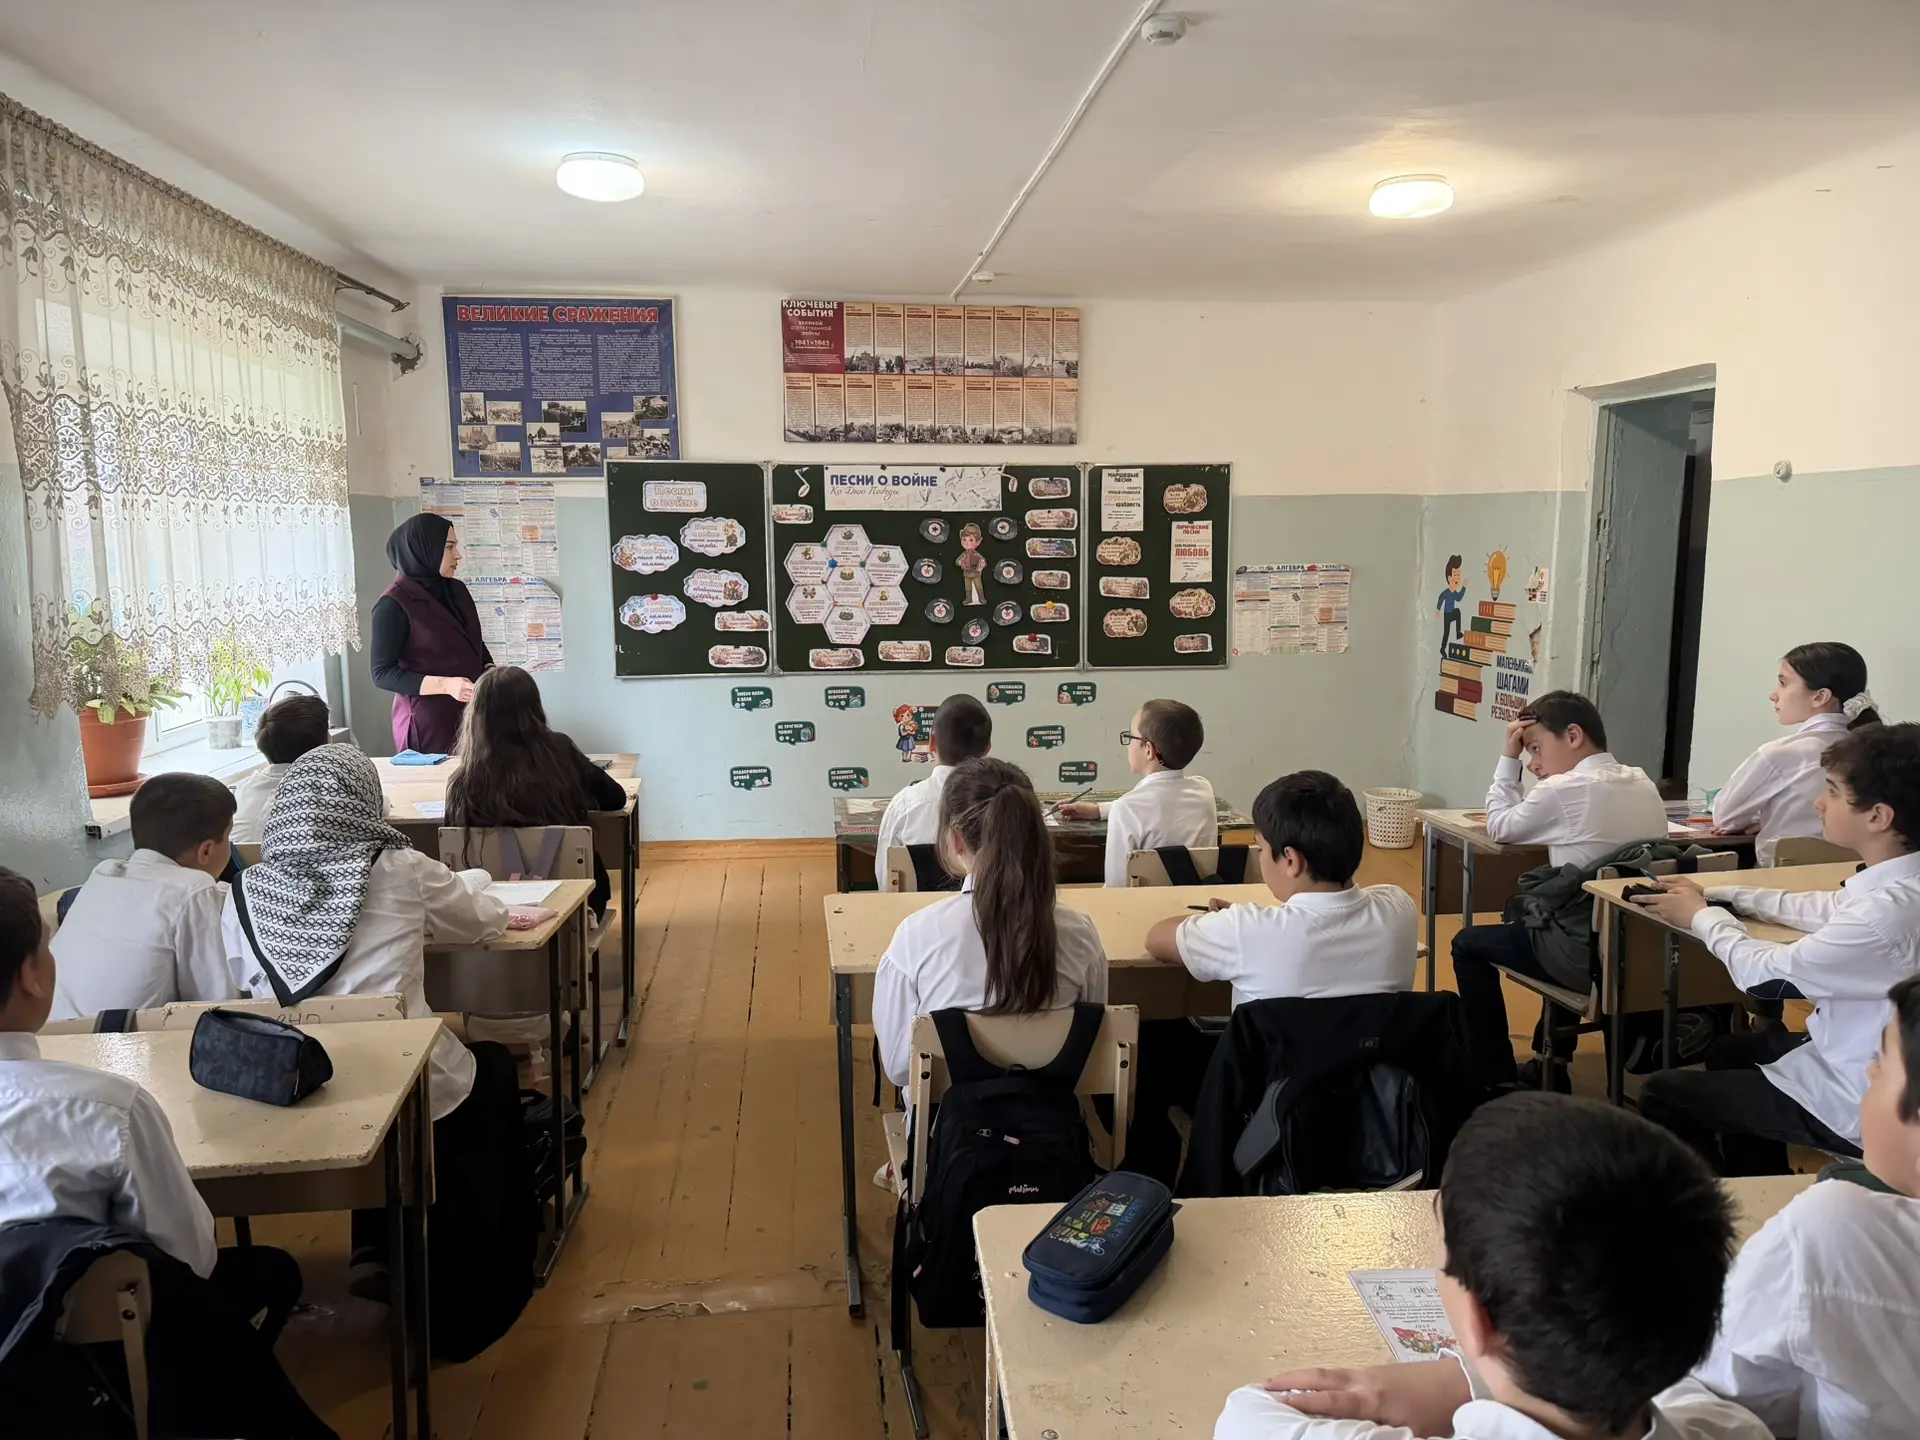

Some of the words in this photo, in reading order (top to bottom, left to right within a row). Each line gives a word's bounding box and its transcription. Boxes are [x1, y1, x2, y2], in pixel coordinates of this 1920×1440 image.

[782, 300, 838, 309] КЛЮЧЕВЫЕ
[457, 305, 549, 322] ВЕЛИКИЕ
[553, 306, 659, 322] СРАЖЕНИЯ
[787, 309, 834, 318] СОБЫТИЯ
[830, 474, 874, 486] ПЕСНИ
[878, 475, 888, 486] О
[892, 472, 938, 486] ВОЙНЕ
[654, 486, 694, 495] Песни
[830, 487, 842, 495] Ко
[845, 486, 865, 495] Дню
[868, 486, 900, 501] Победы
[660, 497, 699, 507] войне
[1175, 548, 1209, 556] ЛЮБОВЬ
[1496, 672, 1529, 695] ШАГАМИ
[1495, 692, 1499, 704] К
[1491, 705, 1519, 722] РЕЗУЛЬТ
